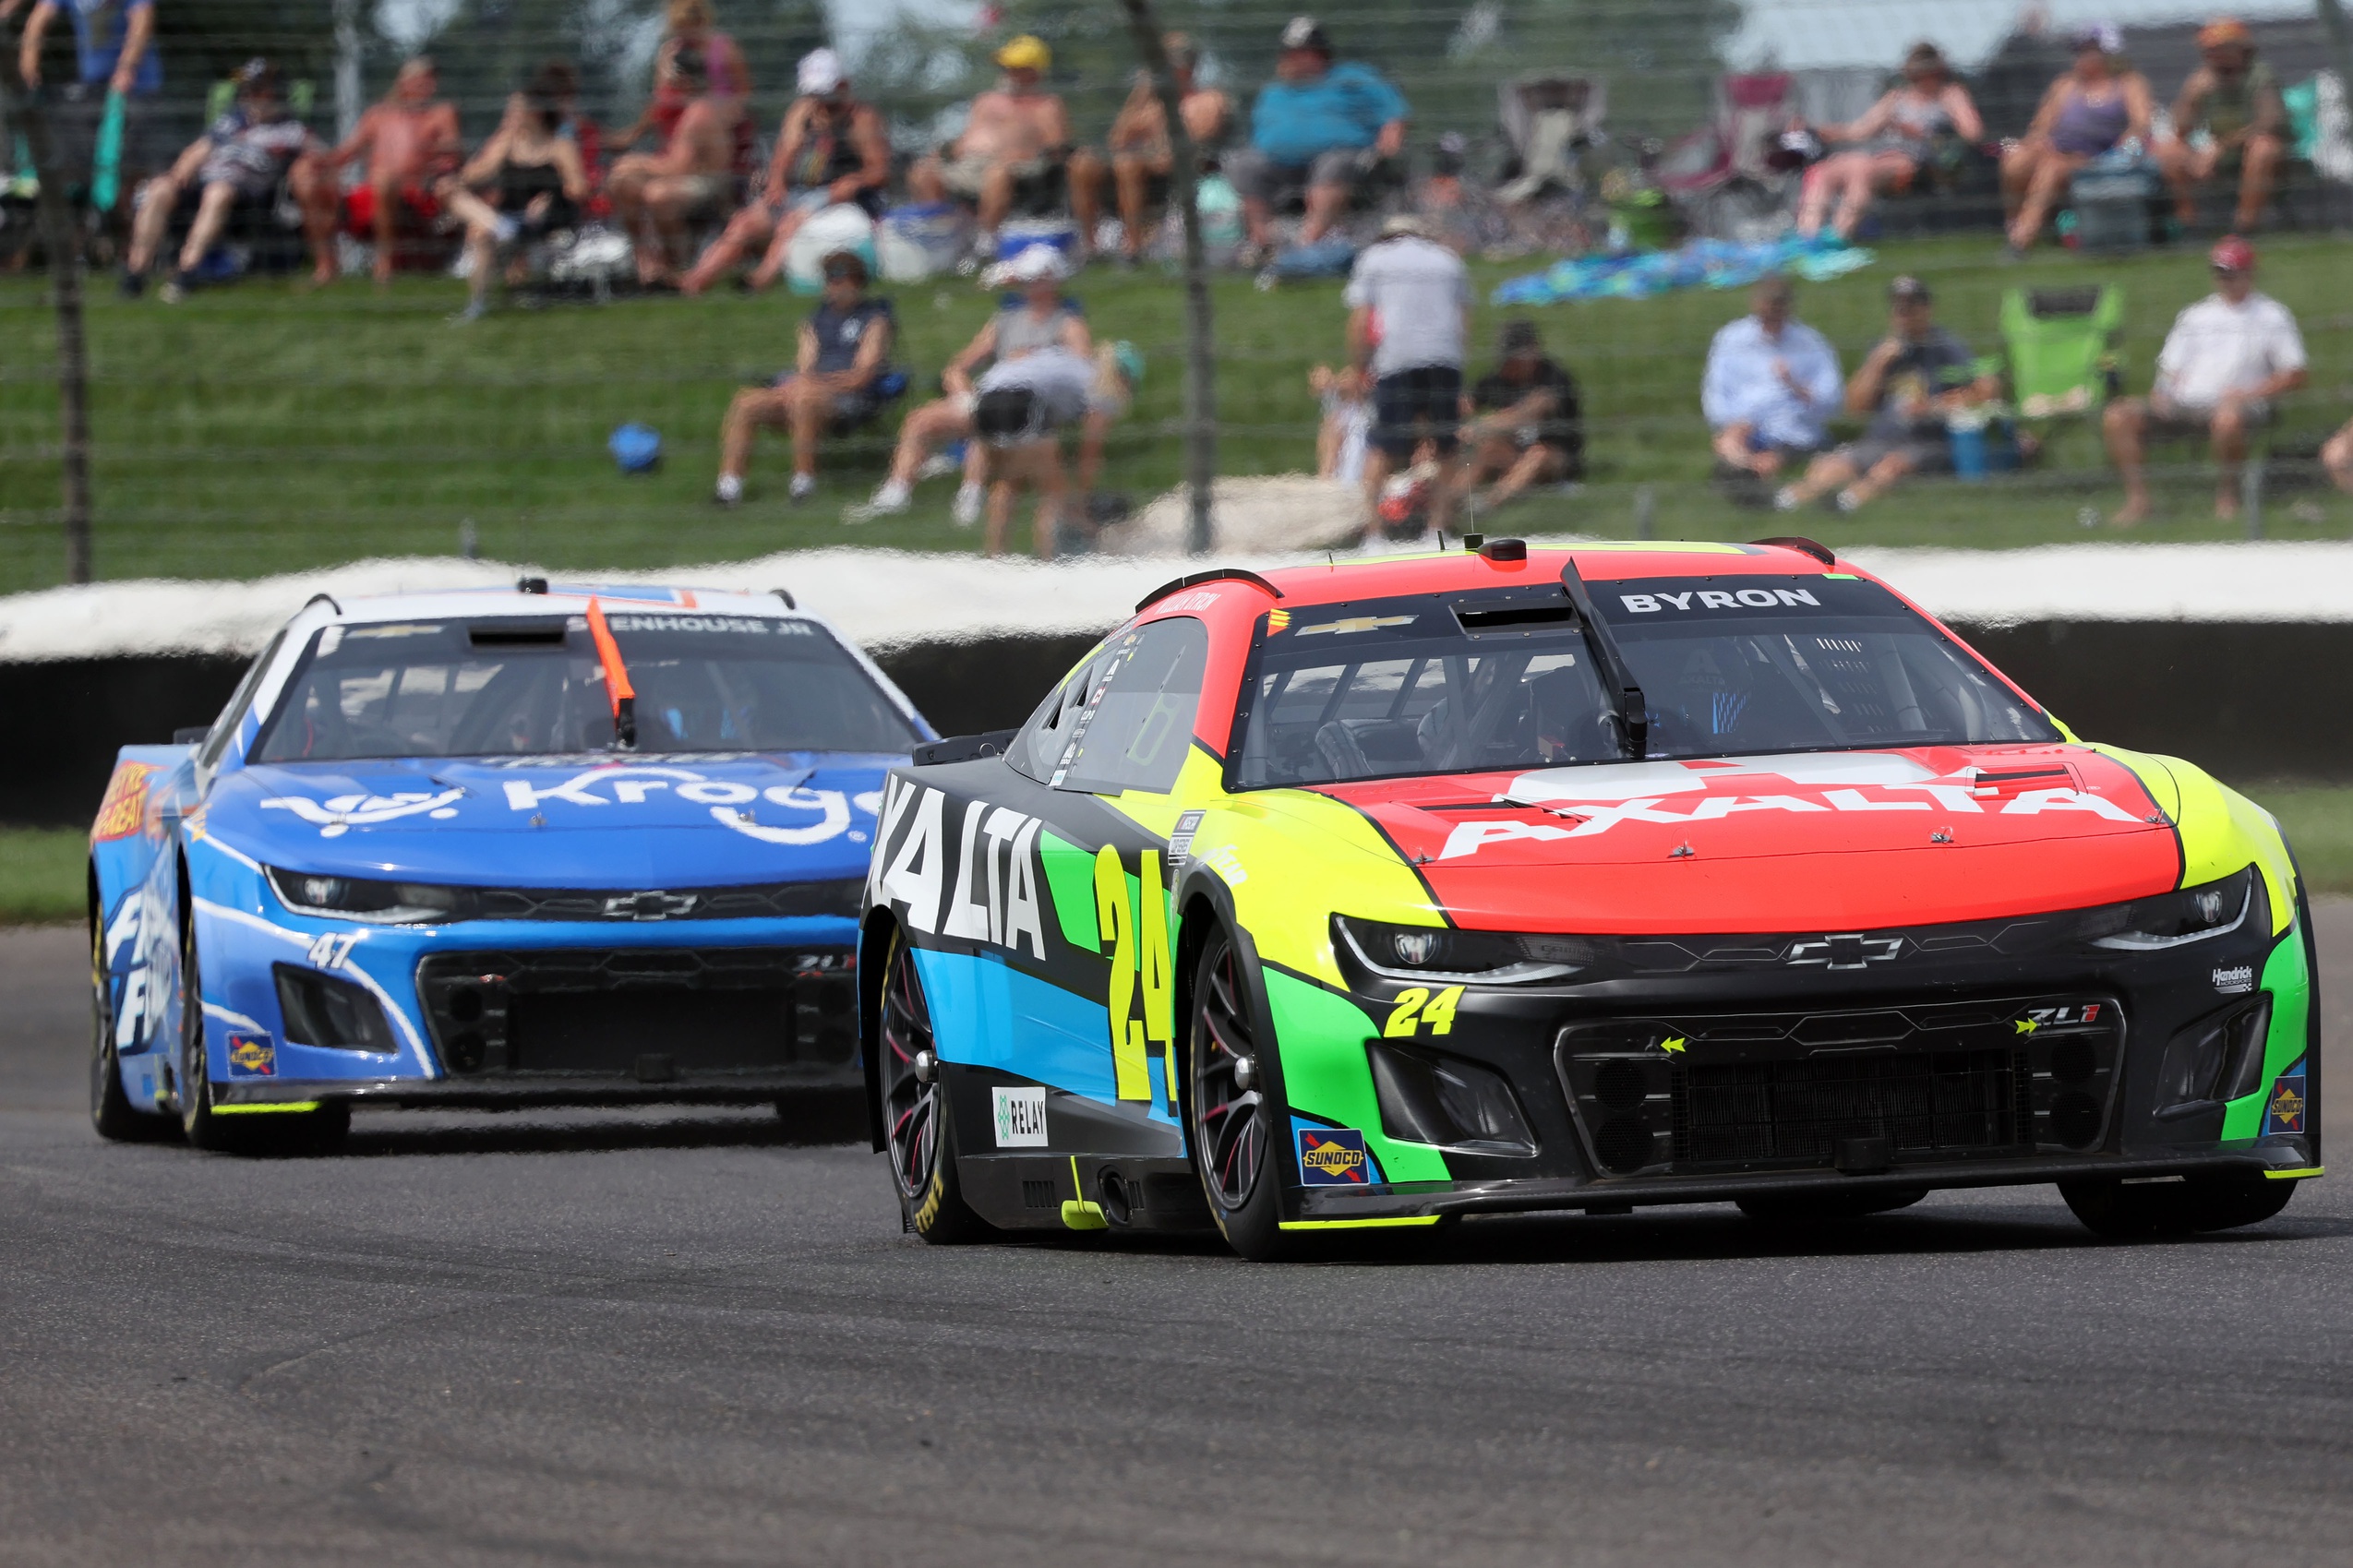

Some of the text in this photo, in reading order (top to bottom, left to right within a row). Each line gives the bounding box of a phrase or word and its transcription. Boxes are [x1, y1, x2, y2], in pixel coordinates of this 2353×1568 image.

[1619, 588, 1821, 613] BYRON
[566, 615, 769, 634] SENHOUSE
[502, 766, 882, 845] Krog
[1438, 783, 2146, 860] AXALTA
[308, 932, 358, 969] 47
[1094, 844, 1177, 1102] 24
[2212, 965, 2252, 986] Hendrick
[1384, 985, 1466, 1038] 24
[2028, 1004, 2100, 1026] ZL1
[231, 1048, 273, 1063] SUNOCO
[1011, 1100, 1044, 1134] RELAY
[2273, 1098, 2301, 1113] SUNOCO
[1306, 1151, 1362, 1166] SUNOCO
